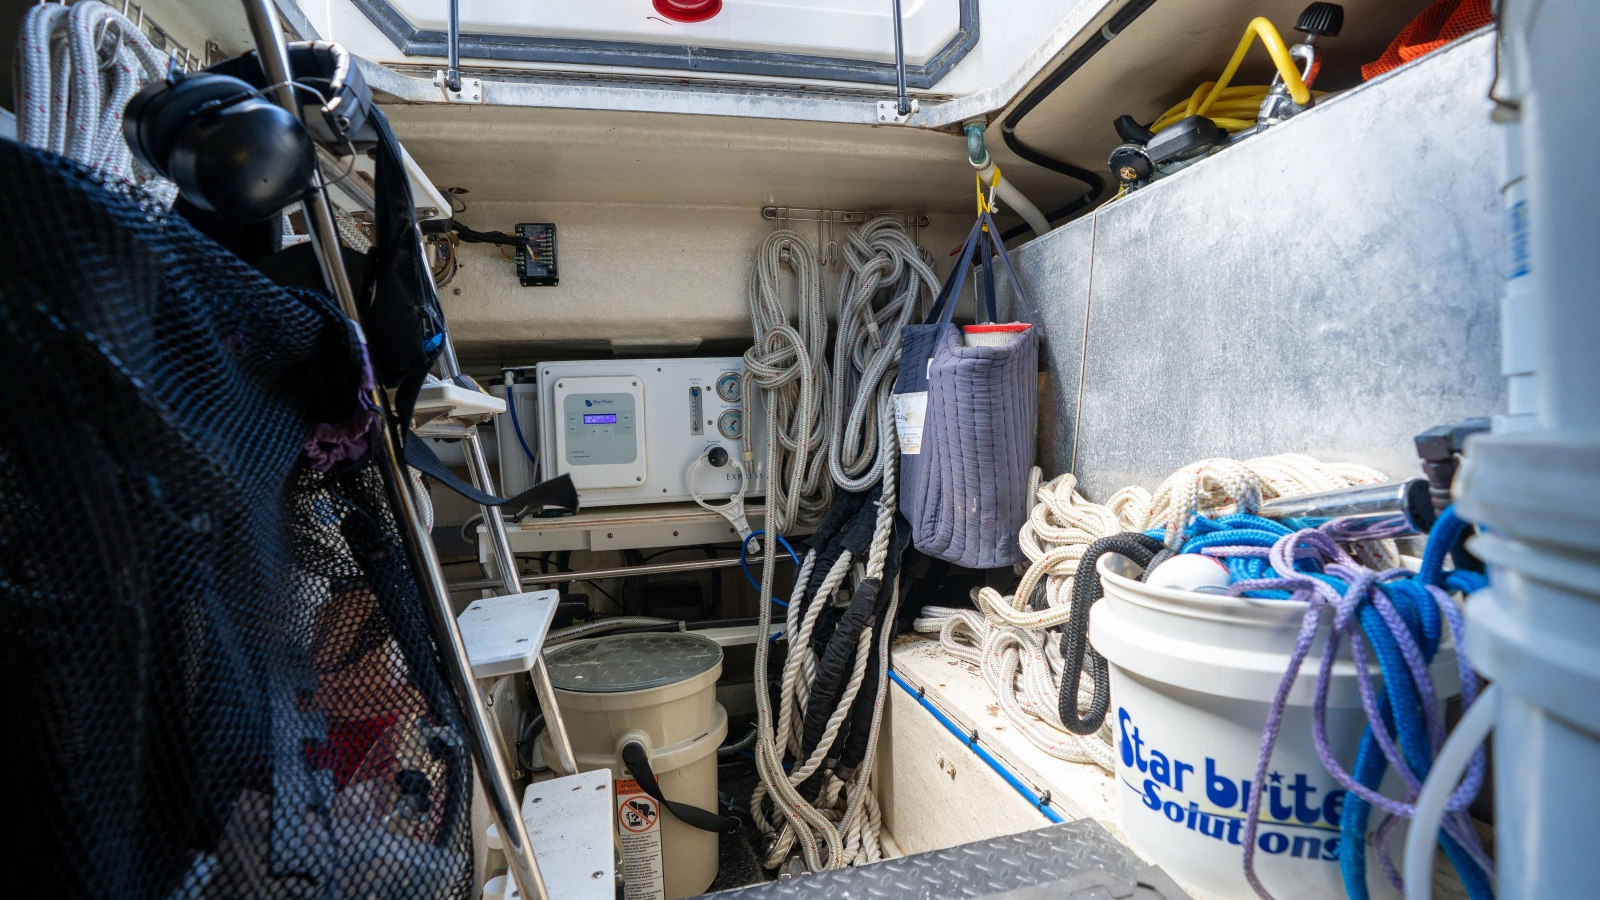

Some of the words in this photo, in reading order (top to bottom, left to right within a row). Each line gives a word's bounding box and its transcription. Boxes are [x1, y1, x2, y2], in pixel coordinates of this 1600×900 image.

[1118, 707, 1194, 793] Star
[1205, 756, 1347, 828] brite
[1142, 779, 1342, 862] Solutons
